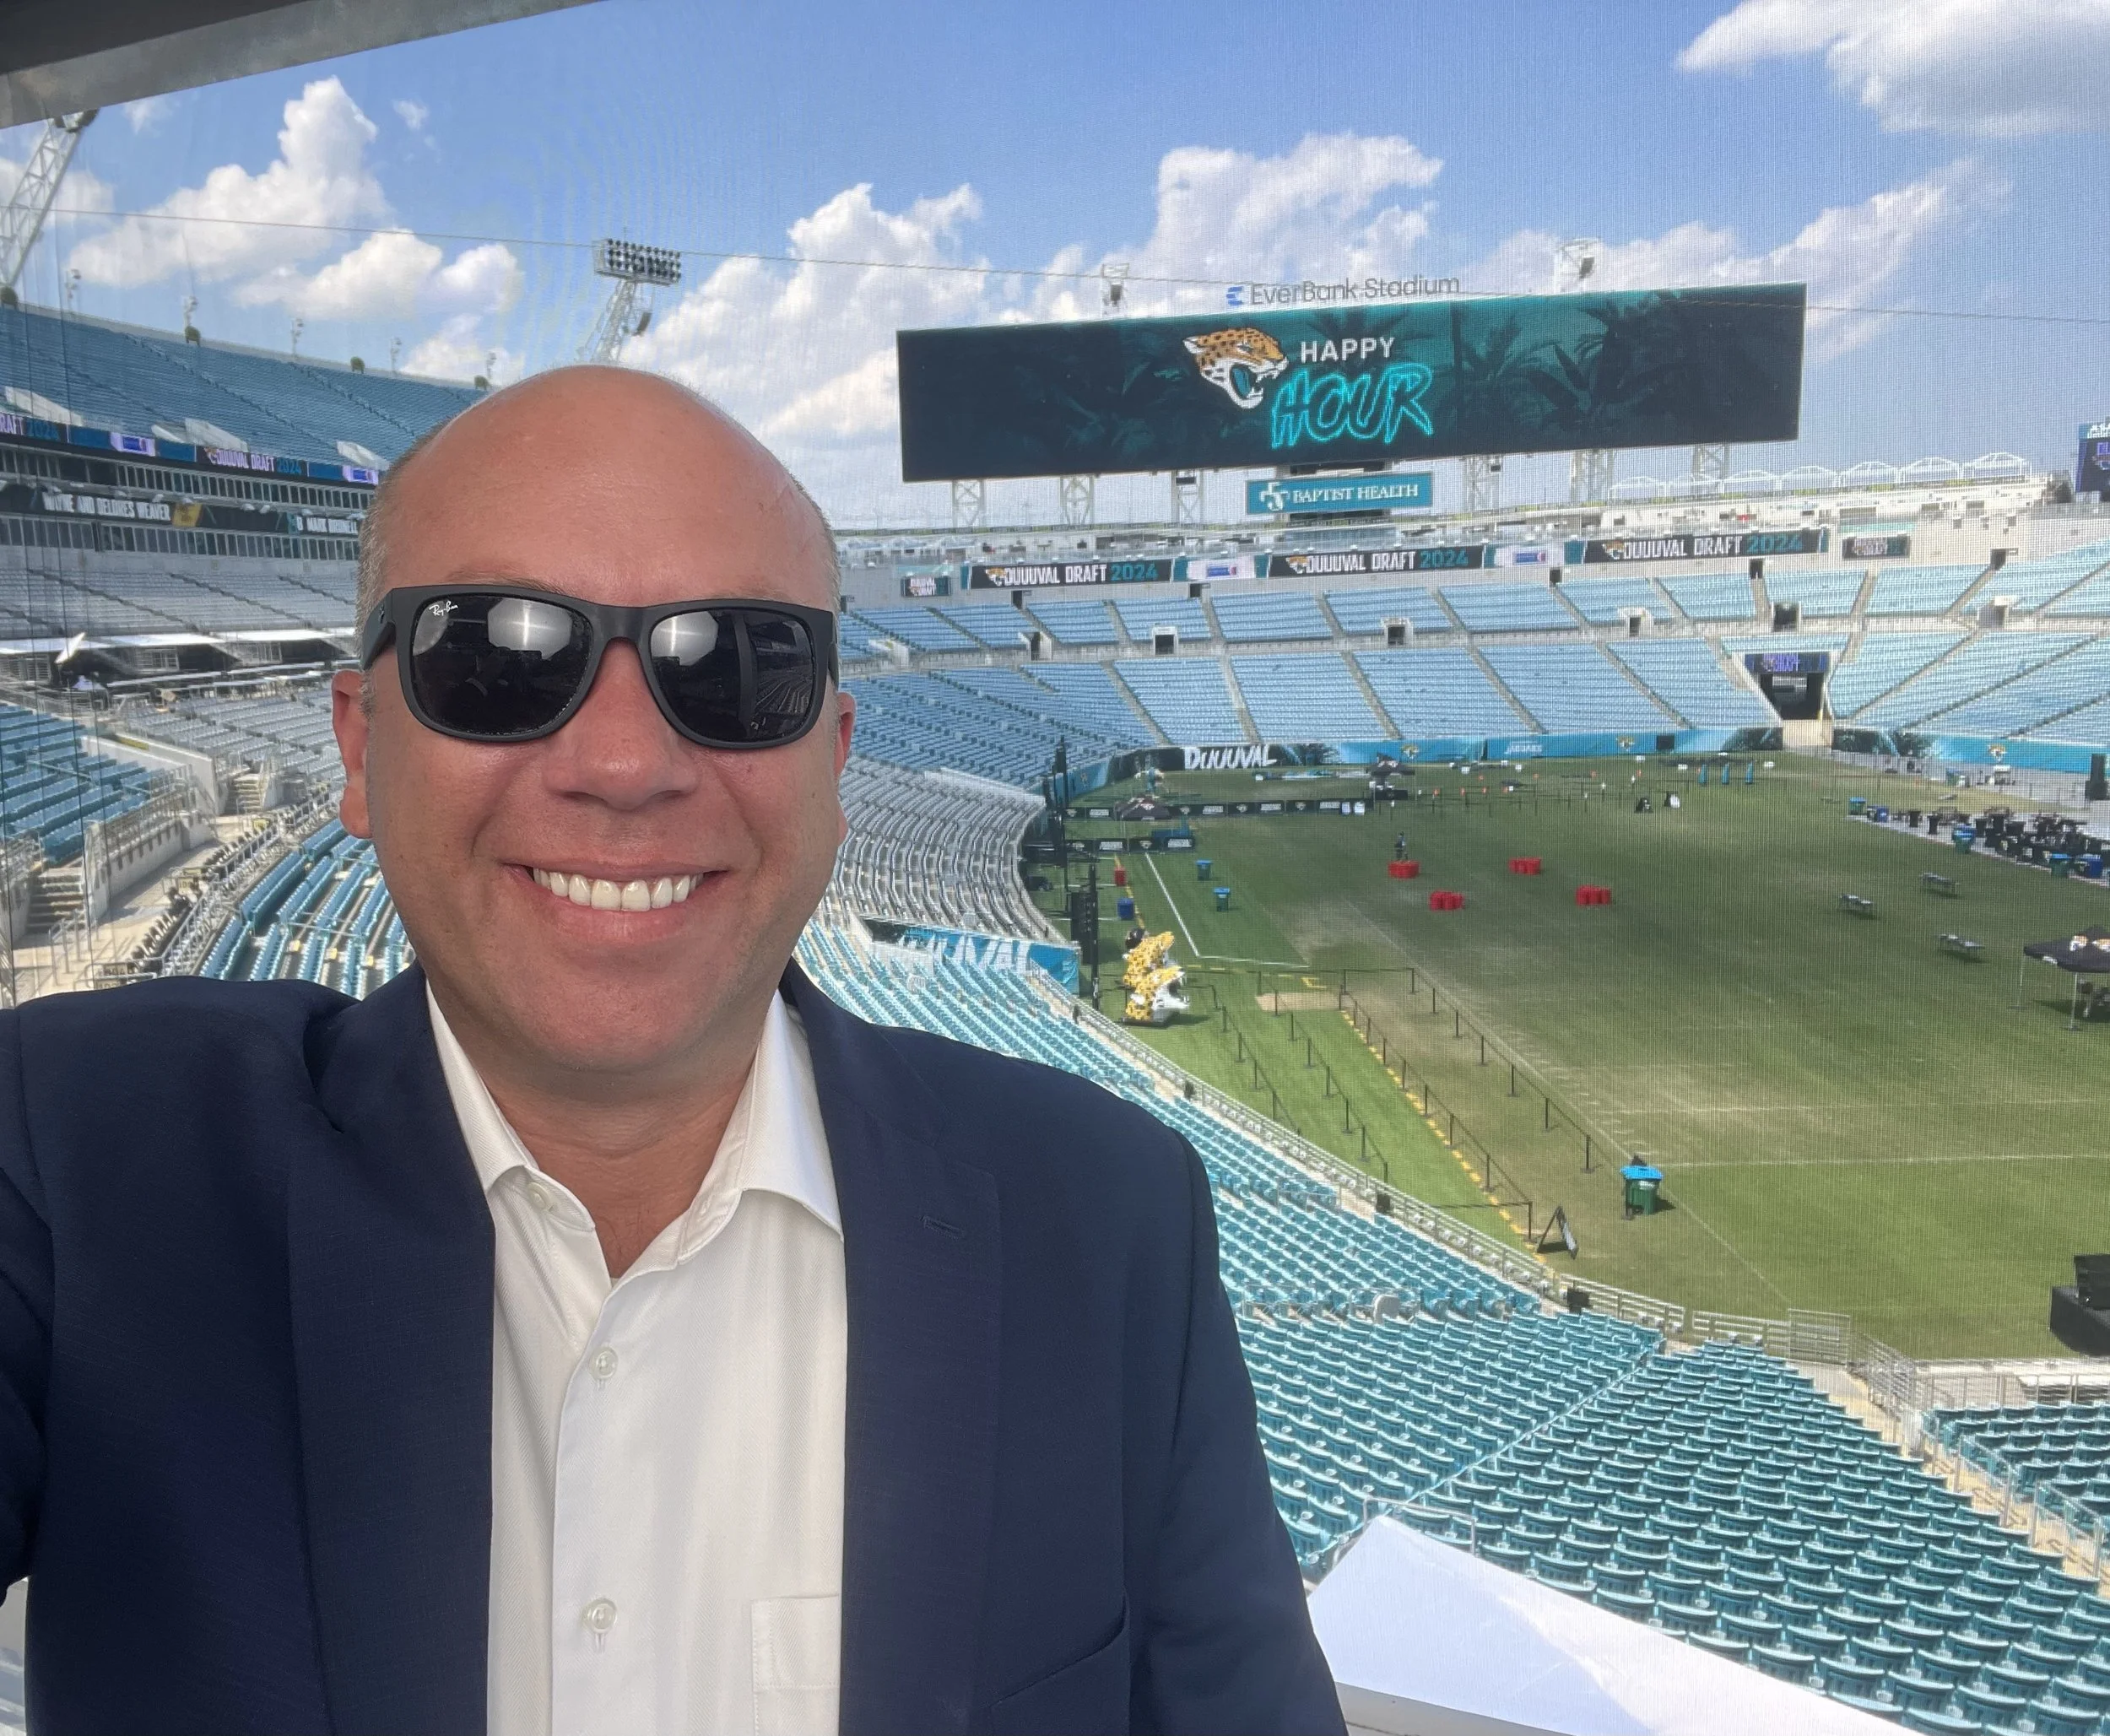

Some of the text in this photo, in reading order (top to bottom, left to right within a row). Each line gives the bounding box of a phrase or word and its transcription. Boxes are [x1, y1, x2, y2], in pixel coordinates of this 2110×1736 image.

[1251, 275, 1460, 305] EverBank Stadium
[1301, 337, 1395, 363] HAPPY
[1270, 362, 1434, 449] HOUR
[0, 412, 24, 435] RAFT
[251, 452, 274, 473] DRAFT
[1292, 484, 1419, 504] BAPTIST HEALTH
[1693, 535, 1744, 557] DRAFT
[1746, 532, 1804, 554] 2024
[1371, 551, 1416, 571] DRAFT
[1420, 548, 1469, 569] 2024
[1065, 564, 1106, 582] DRAFT
[1111, 561, 1159, 581] 2024
[429, 600, 458, 616] Ray-Ban
